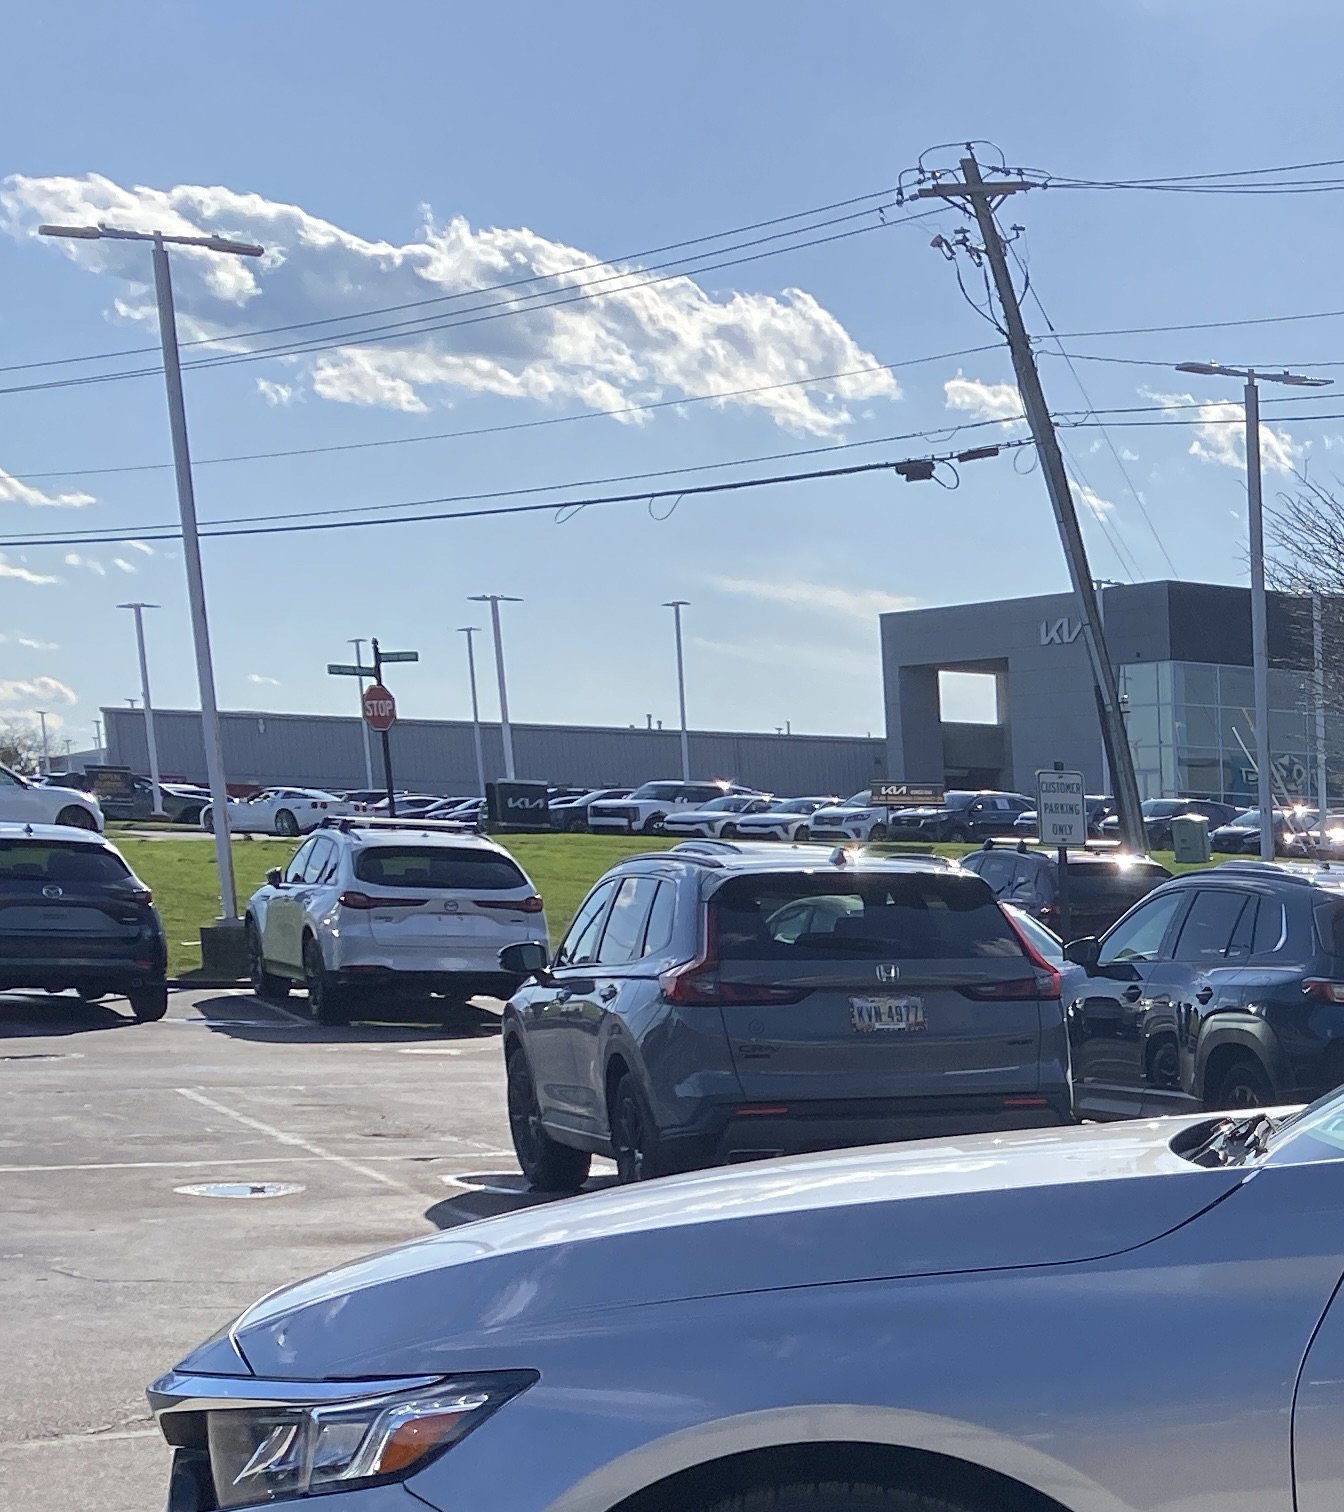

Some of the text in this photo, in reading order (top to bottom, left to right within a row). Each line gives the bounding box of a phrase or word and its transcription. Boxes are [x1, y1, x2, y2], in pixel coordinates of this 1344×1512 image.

[365, 700, 394, 717] STOP
[1041, 782, 1081, 794] CUSTOMER
[1044, 803, 1080, 815] PARKING
[1052, 824, 1073, 835] ONLY
